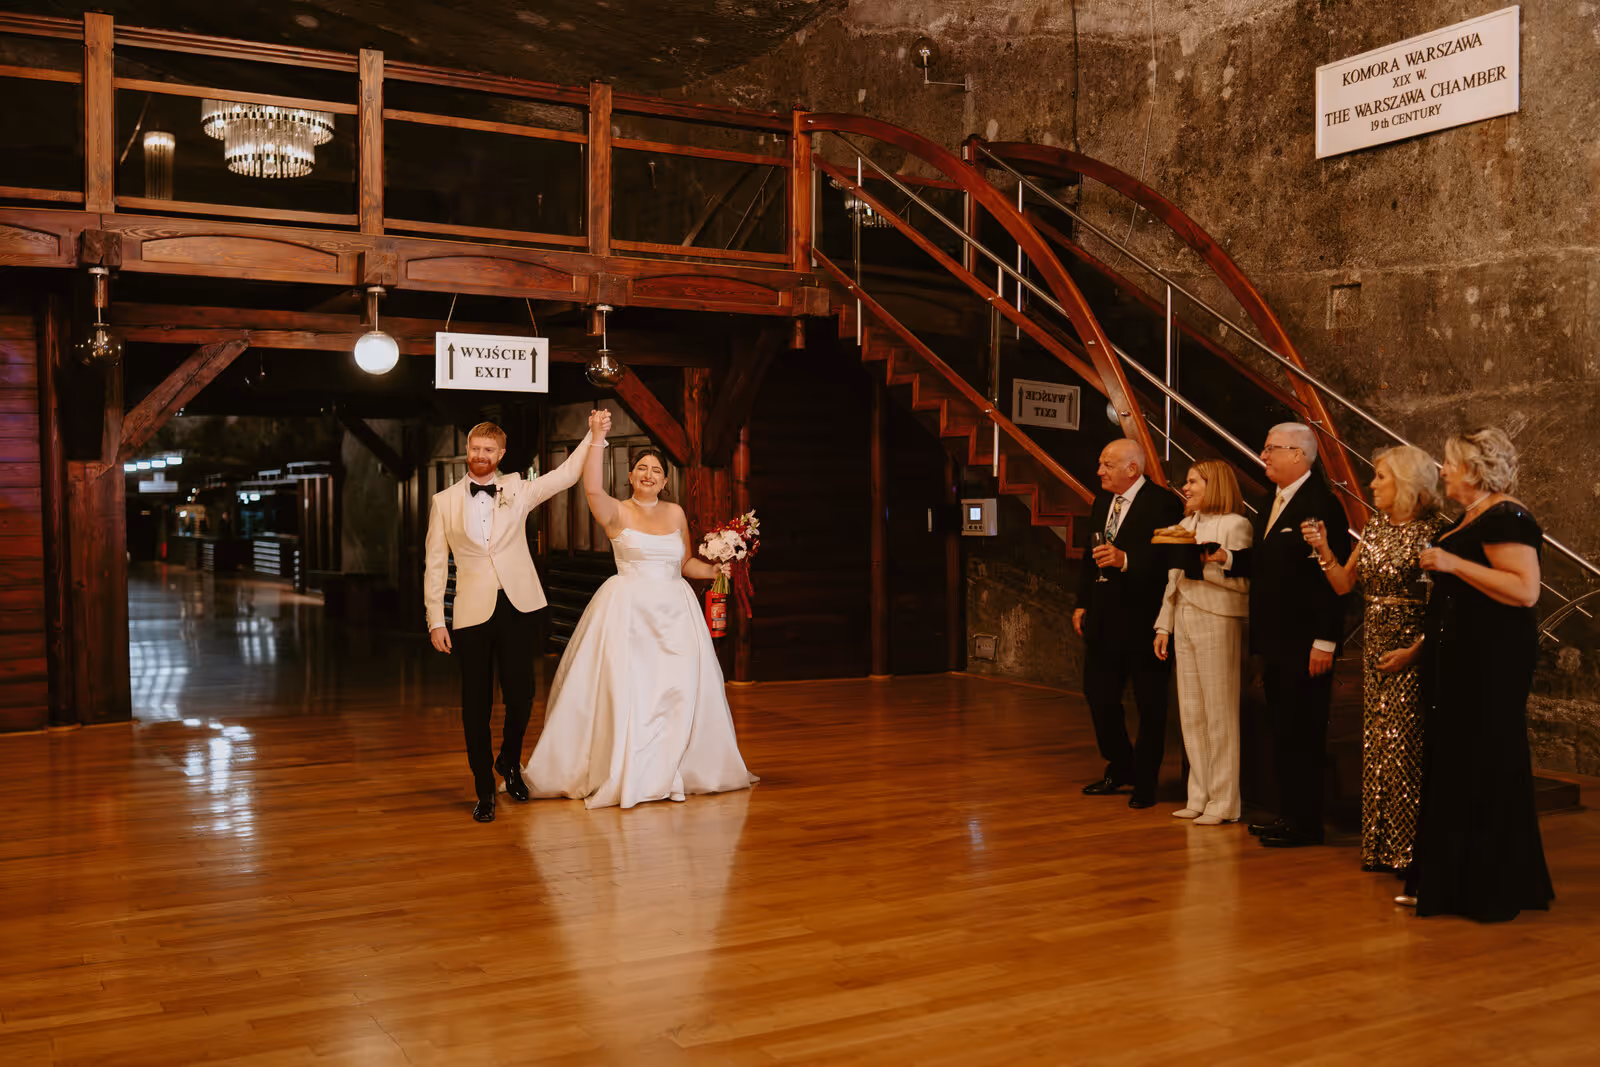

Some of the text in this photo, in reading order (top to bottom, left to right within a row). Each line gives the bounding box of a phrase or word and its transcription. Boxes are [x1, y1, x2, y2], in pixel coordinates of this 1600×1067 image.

[1342, 32, 1483, 86] KOMORA WARSZAWA
[1392, 69, 1427, 88] XIX W.
[1325, 65, 1507, 127] THE WARSZAWA CHAMBER
[1391, 103, 1442, 126] CENTURY
[460, 345, 527, 361] WYJŚCIE
[475, 366, 511, 379] EXIT
